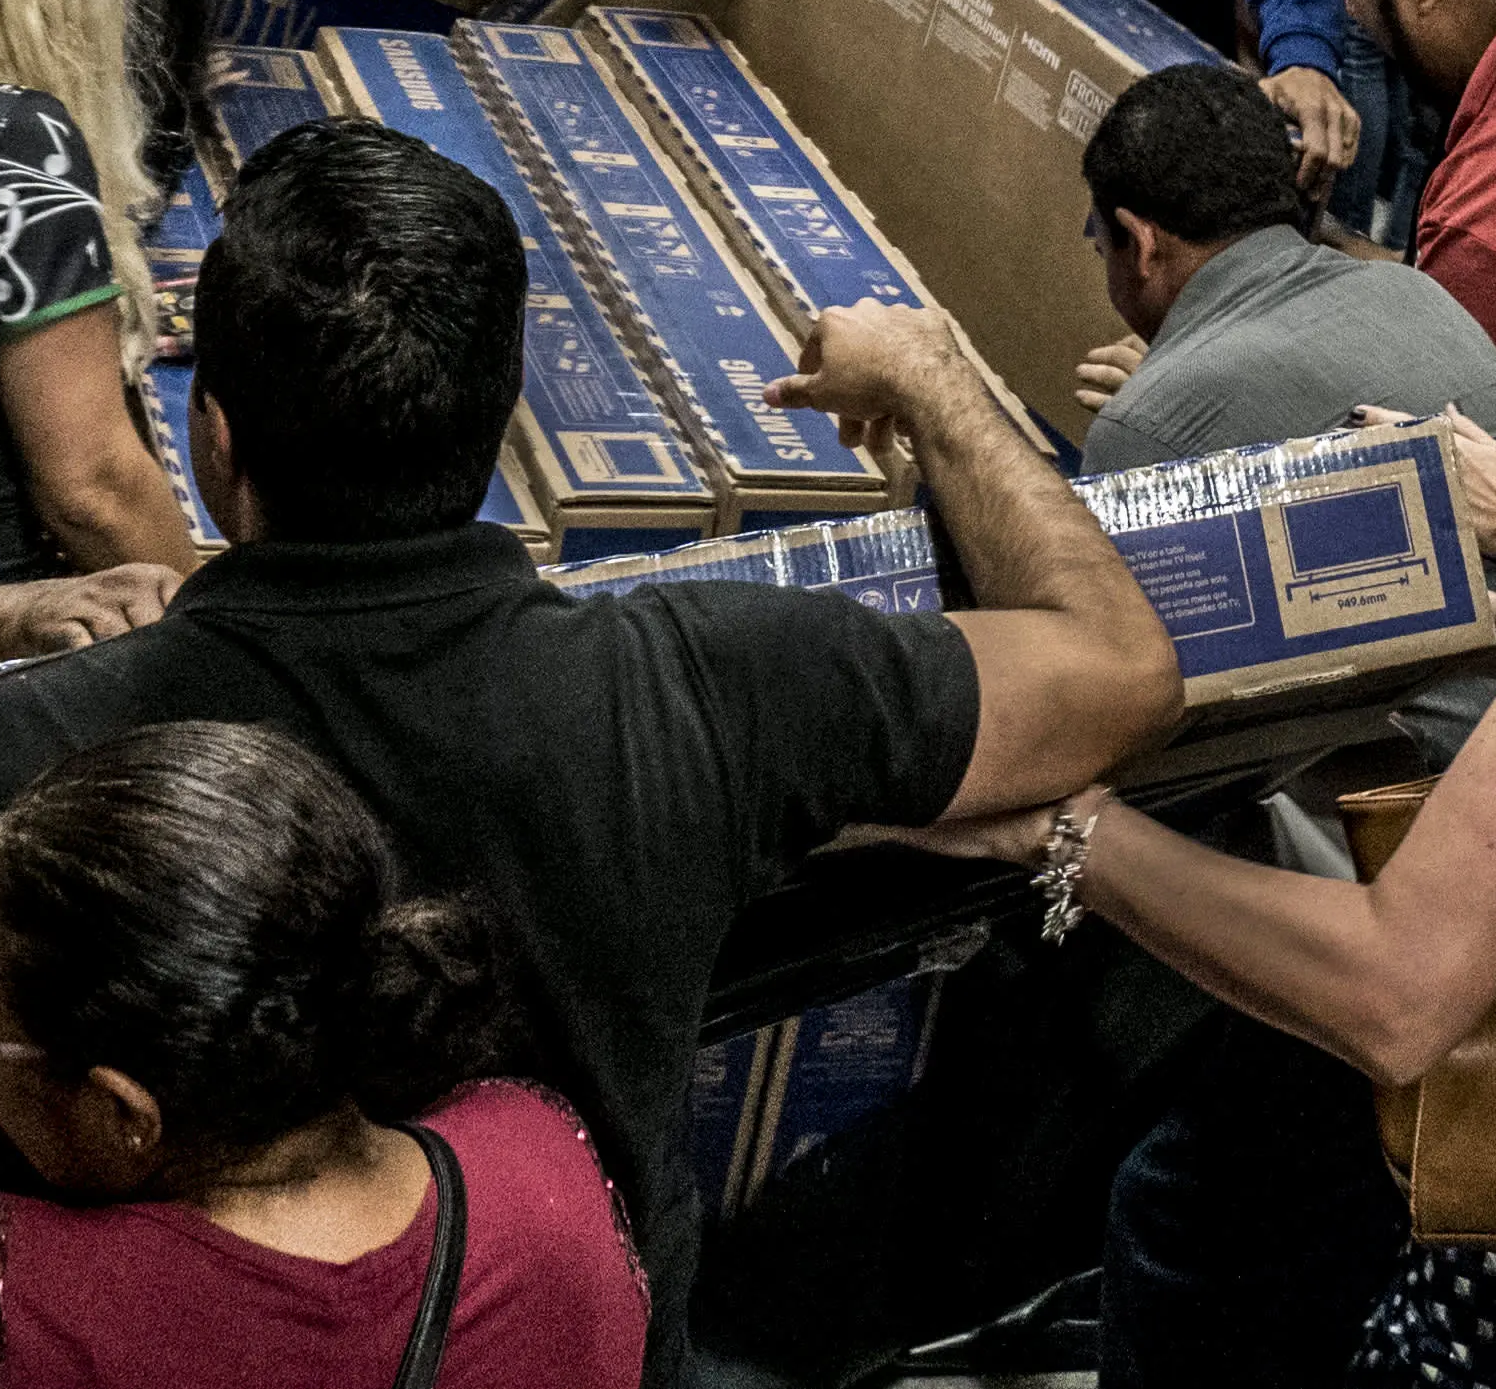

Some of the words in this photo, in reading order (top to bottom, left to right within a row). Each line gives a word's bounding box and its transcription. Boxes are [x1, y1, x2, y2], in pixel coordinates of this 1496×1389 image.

[1020, 30, 1062, 71] HDMI
[377, 37, 446, 111] SAMSUNG
[1190, 593, 1212, 604] mesa
[1212, 591, 1228, 602] que
[1337, 592, 1388, 611] 949.6mm
